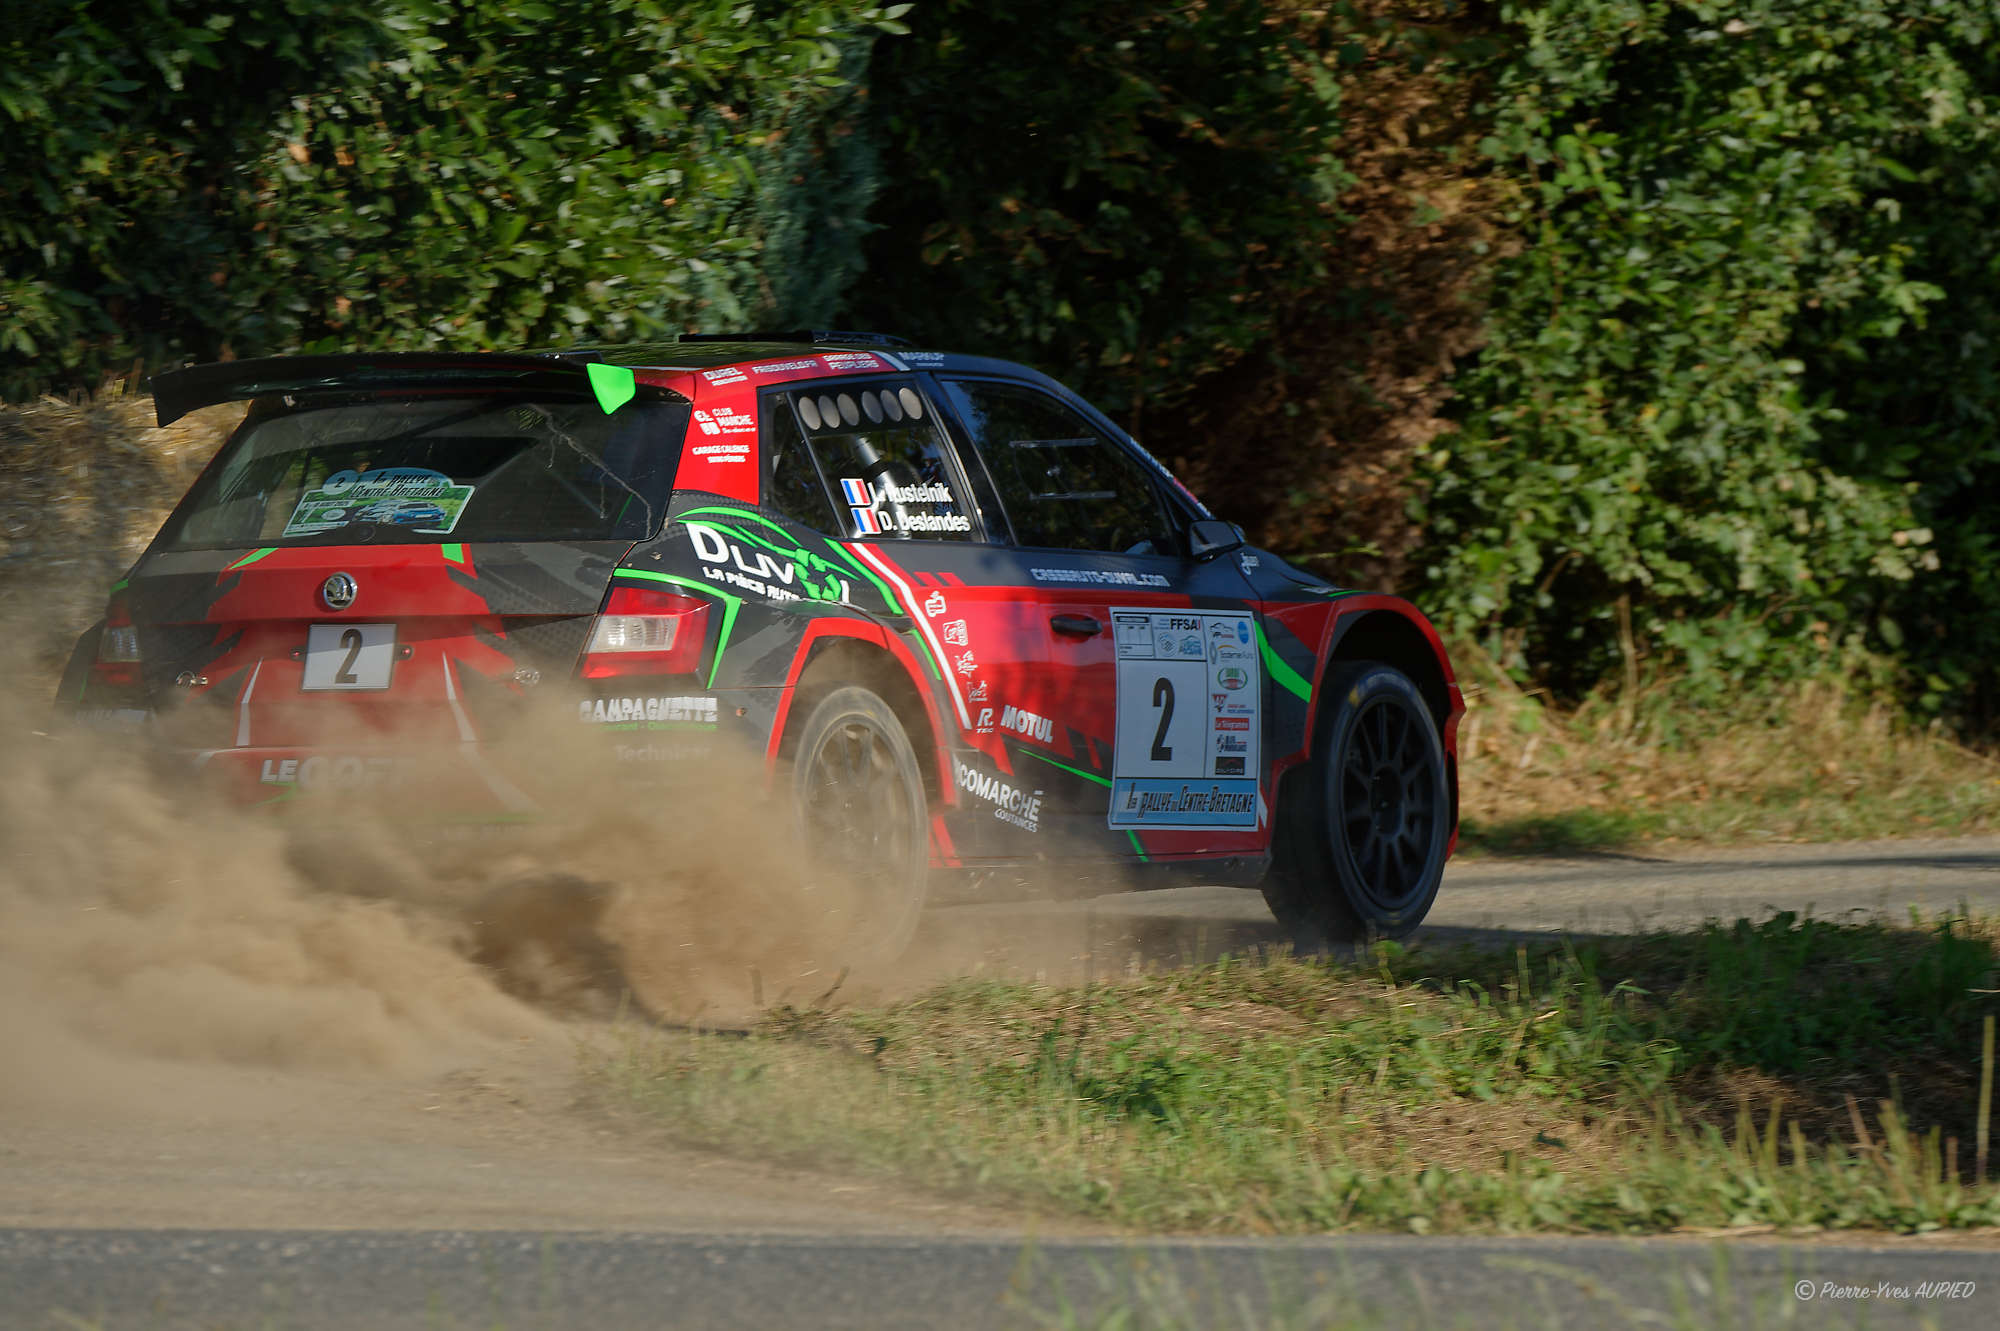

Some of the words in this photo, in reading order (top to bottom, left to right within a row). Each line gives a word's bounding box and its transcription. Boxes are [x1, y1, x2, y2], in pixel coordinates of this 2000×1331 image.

[335, 628, 363, 684] 2
[1000, 704, 1053, 743] MOTUL
[1151, 677, 1175, 761] 2
[994, 808, 1038, 833] COUTANCES
